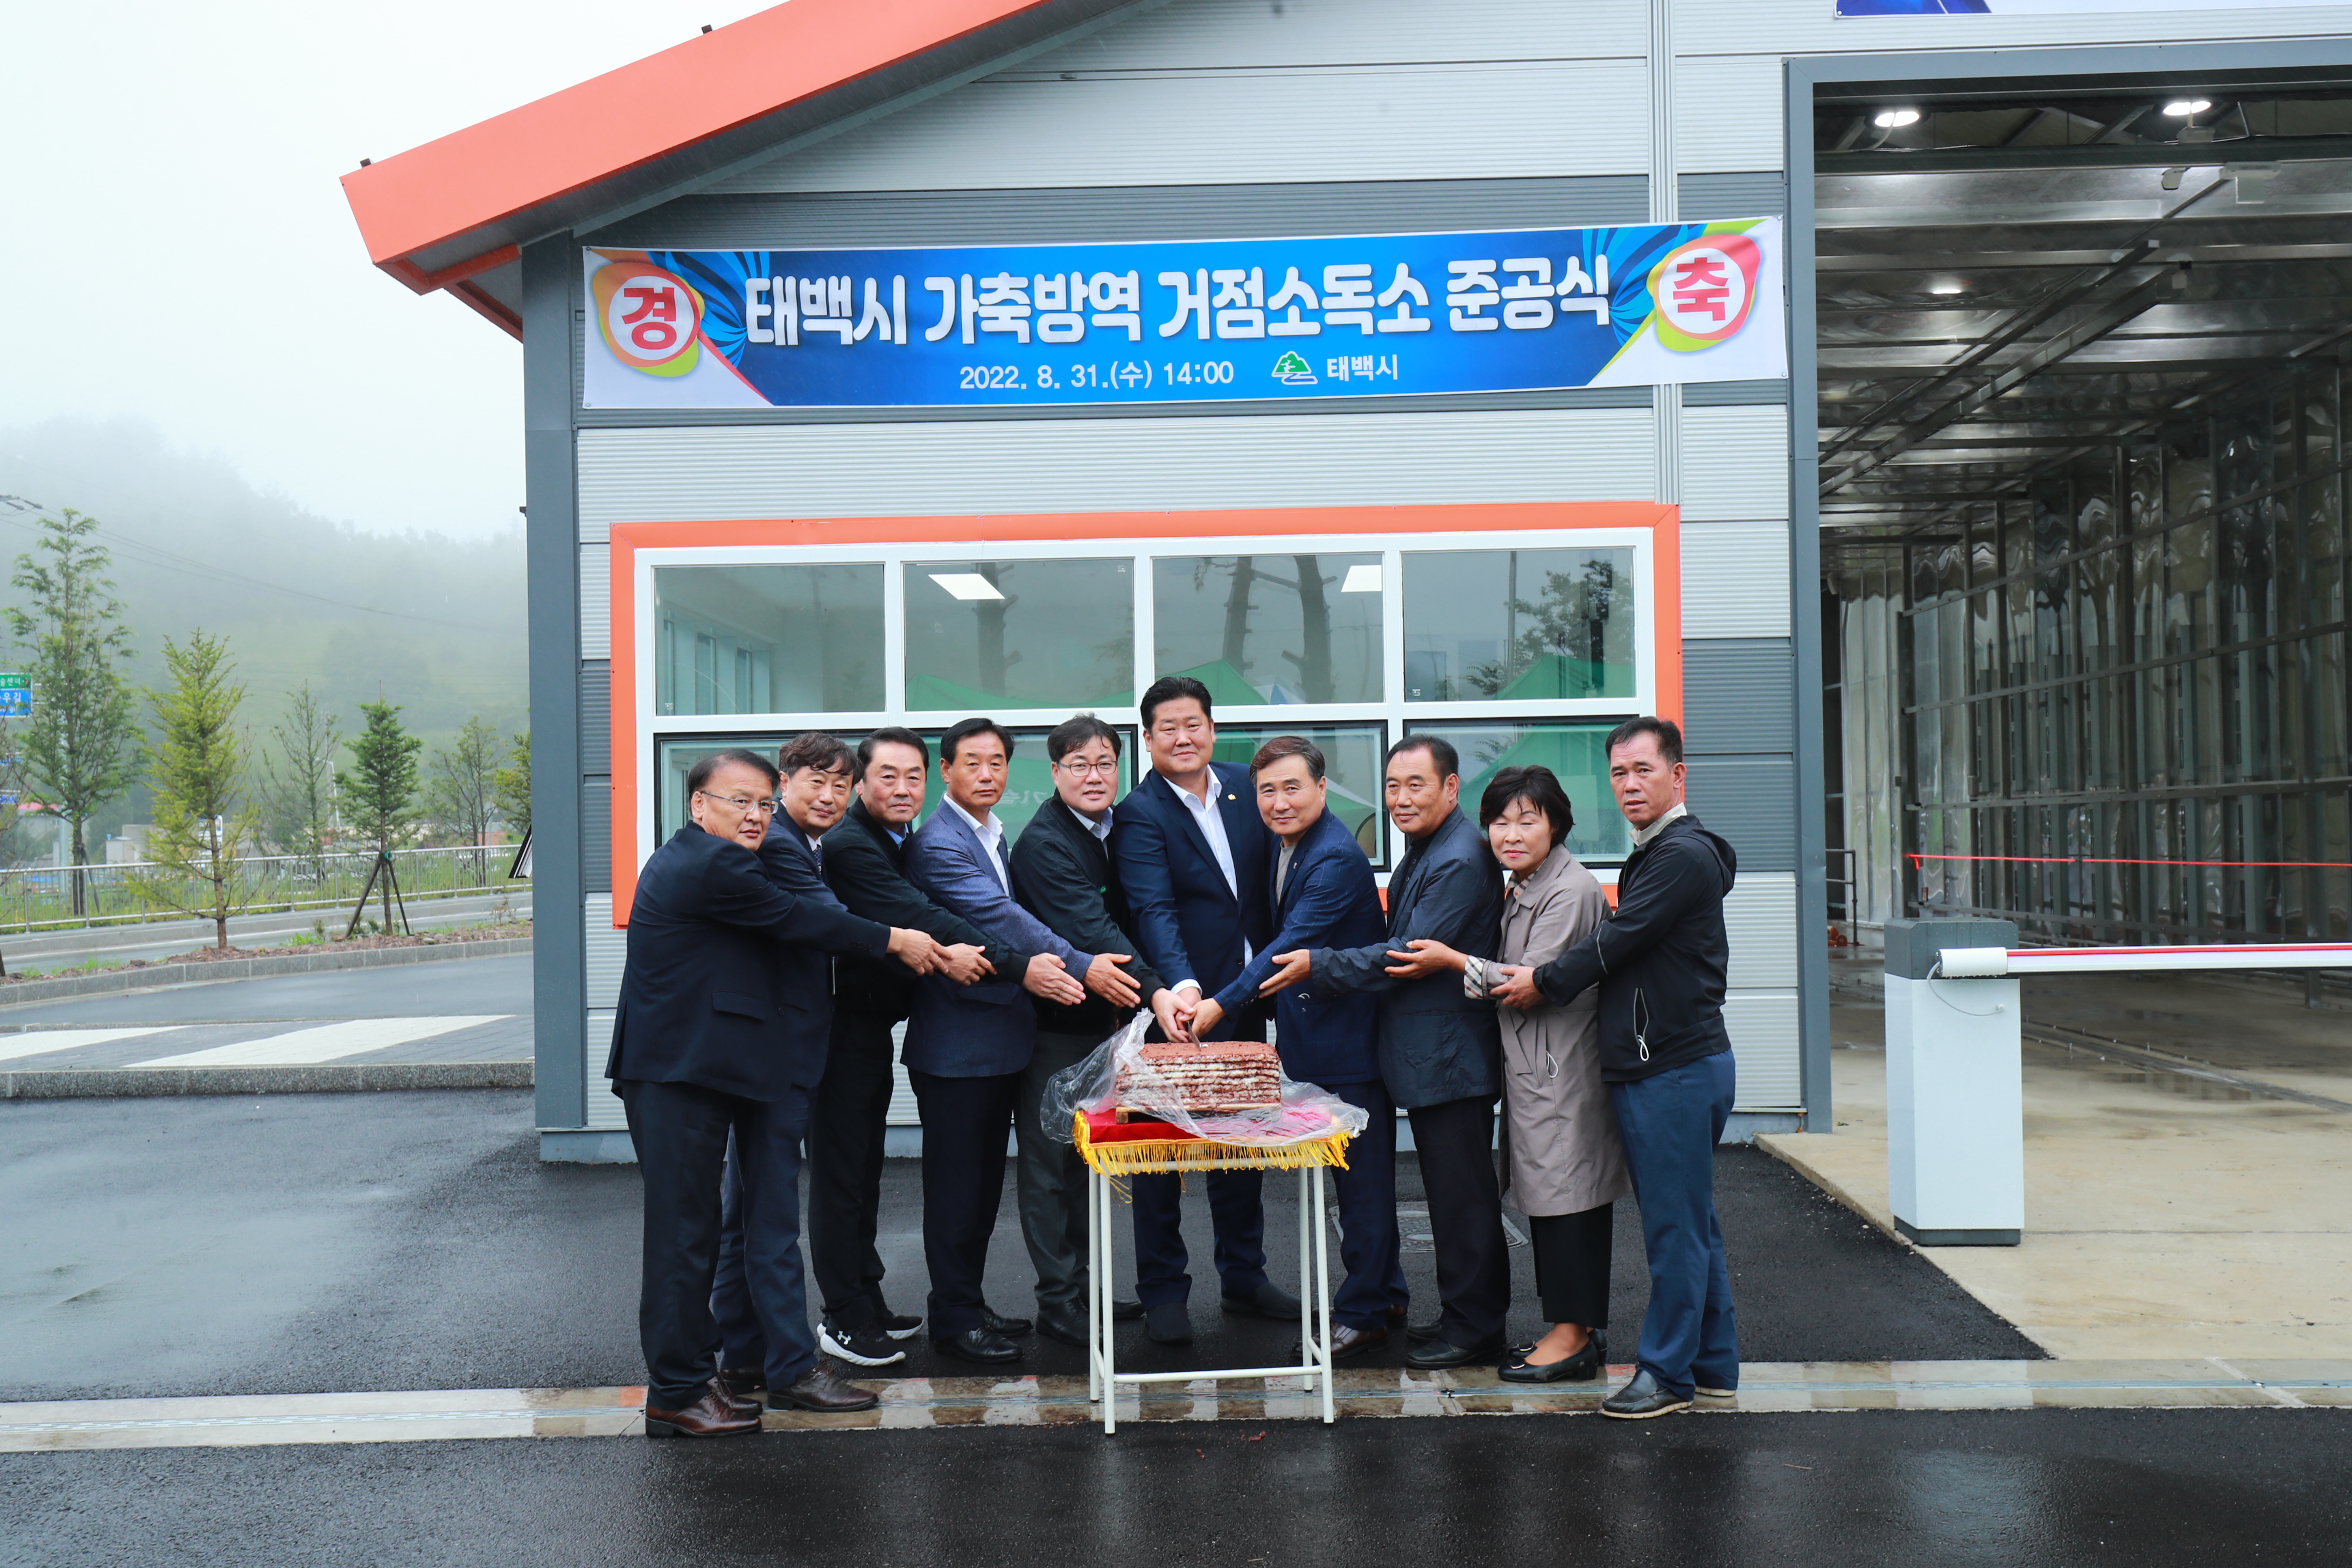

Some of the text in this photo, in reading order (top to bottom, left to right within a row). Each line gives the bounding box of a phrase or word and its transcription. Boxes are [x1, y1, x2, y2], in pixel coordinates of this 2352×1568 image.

[622, 286, 677, 351] 경
[745, 254, 1610, 346] 태백시 가축방역 거점소독소 준공식
[1673, 257, 1730, 321] 축
[960, 360, 1234, 390] 2022. 8. 31.(수) 14:00
[1327, 354, 1398, 382] 태백시
